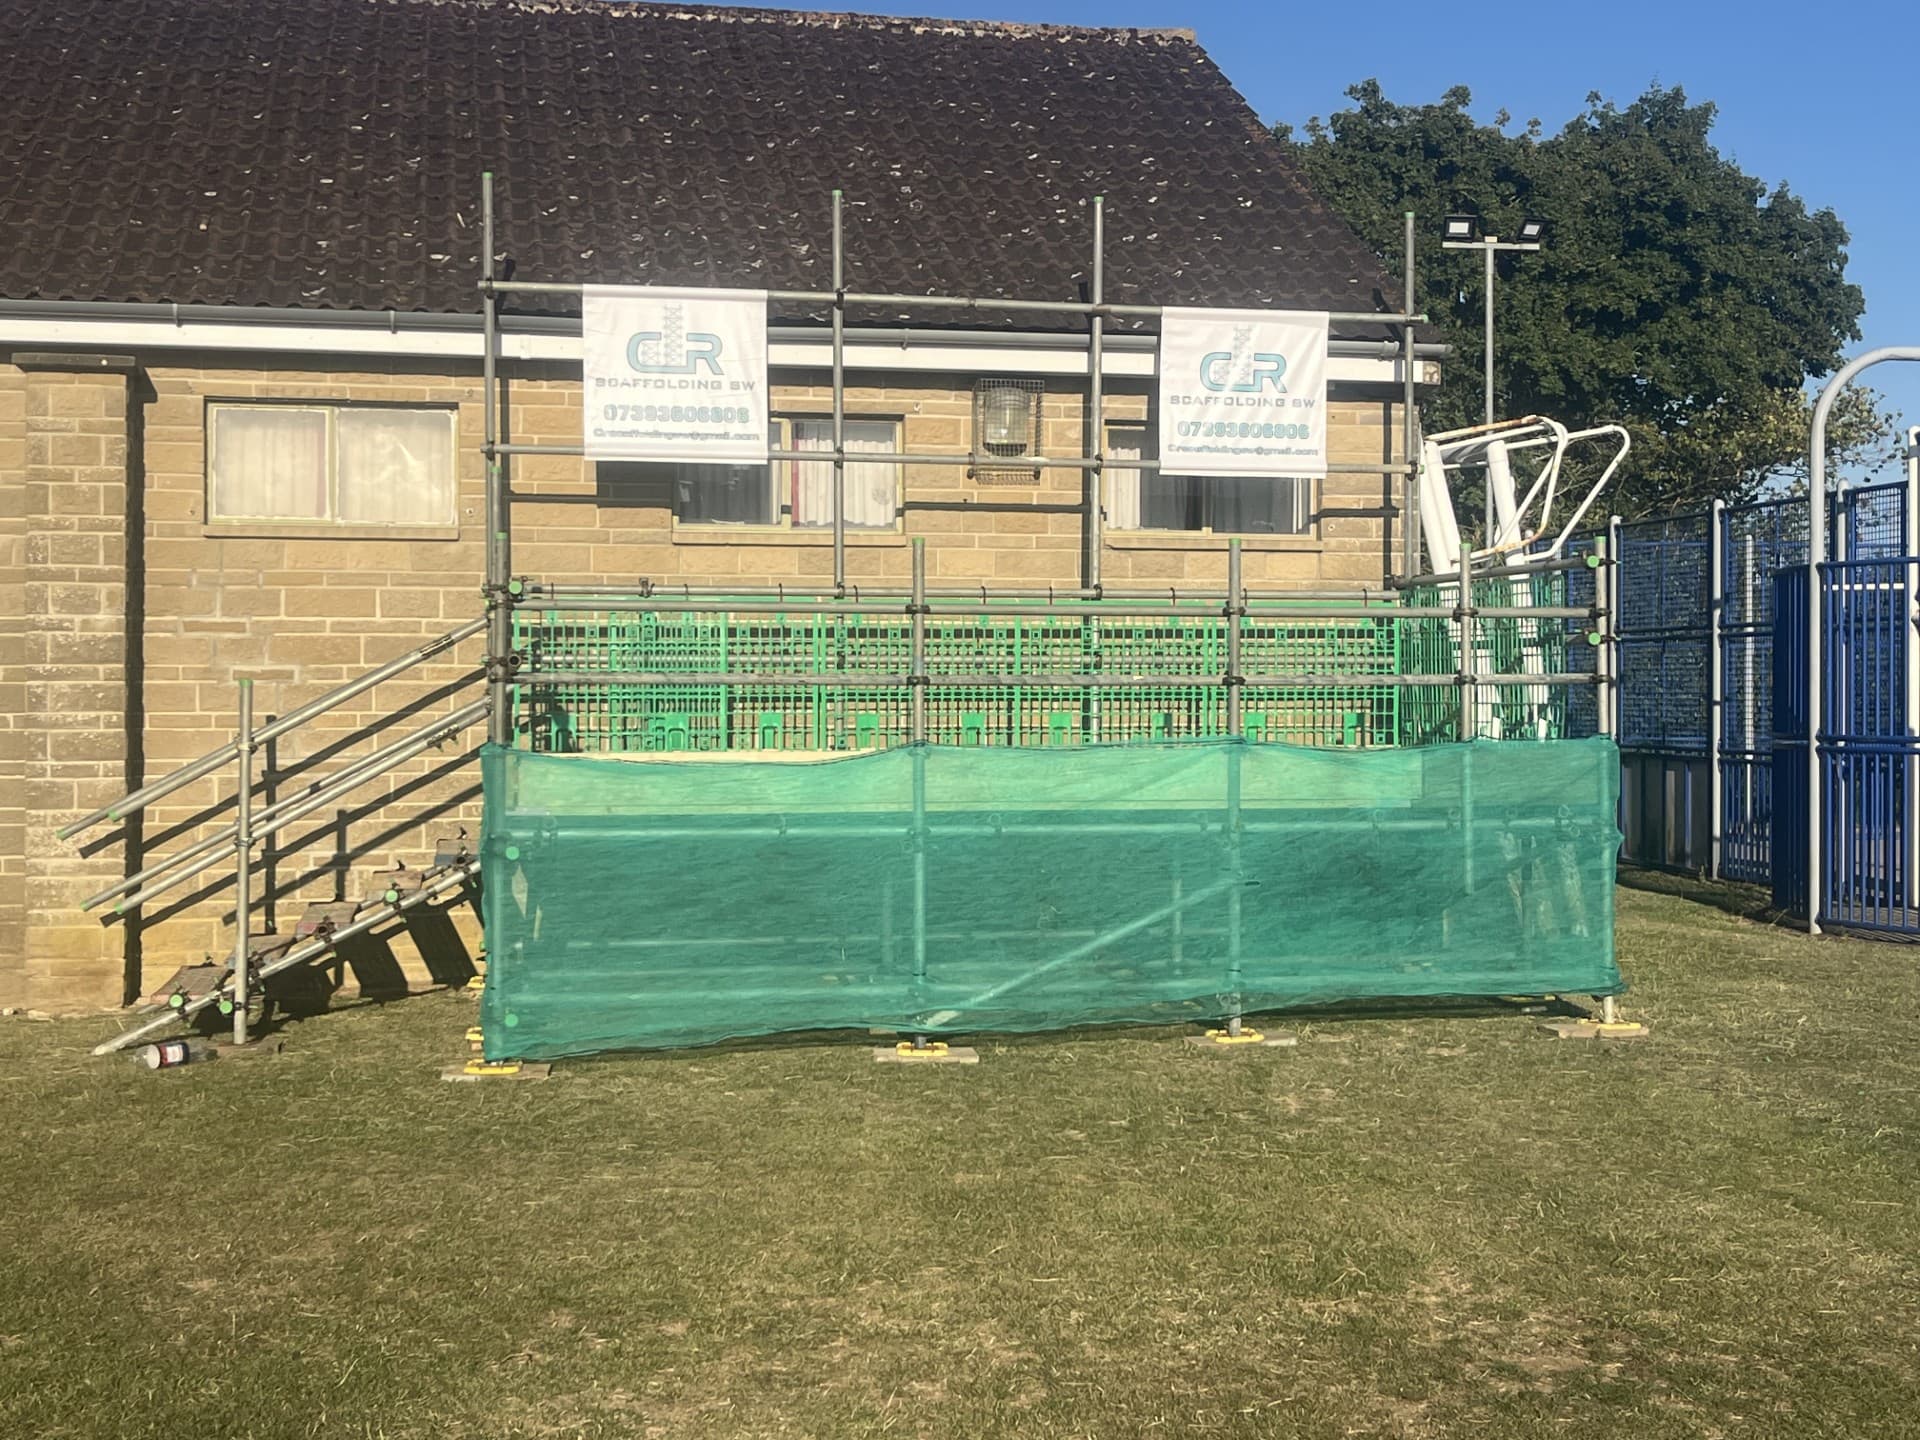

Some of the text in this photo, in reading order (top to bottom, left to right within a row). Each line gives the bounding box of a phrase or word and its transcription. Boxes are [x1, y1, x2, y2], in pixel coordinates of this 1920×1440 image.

[595, 378, 756, 391] SCAFFOLDING SW
[1170, 395, 1316, 408] SCAFFOLDING SW
[603, 404, 750, 424] 07393606806
